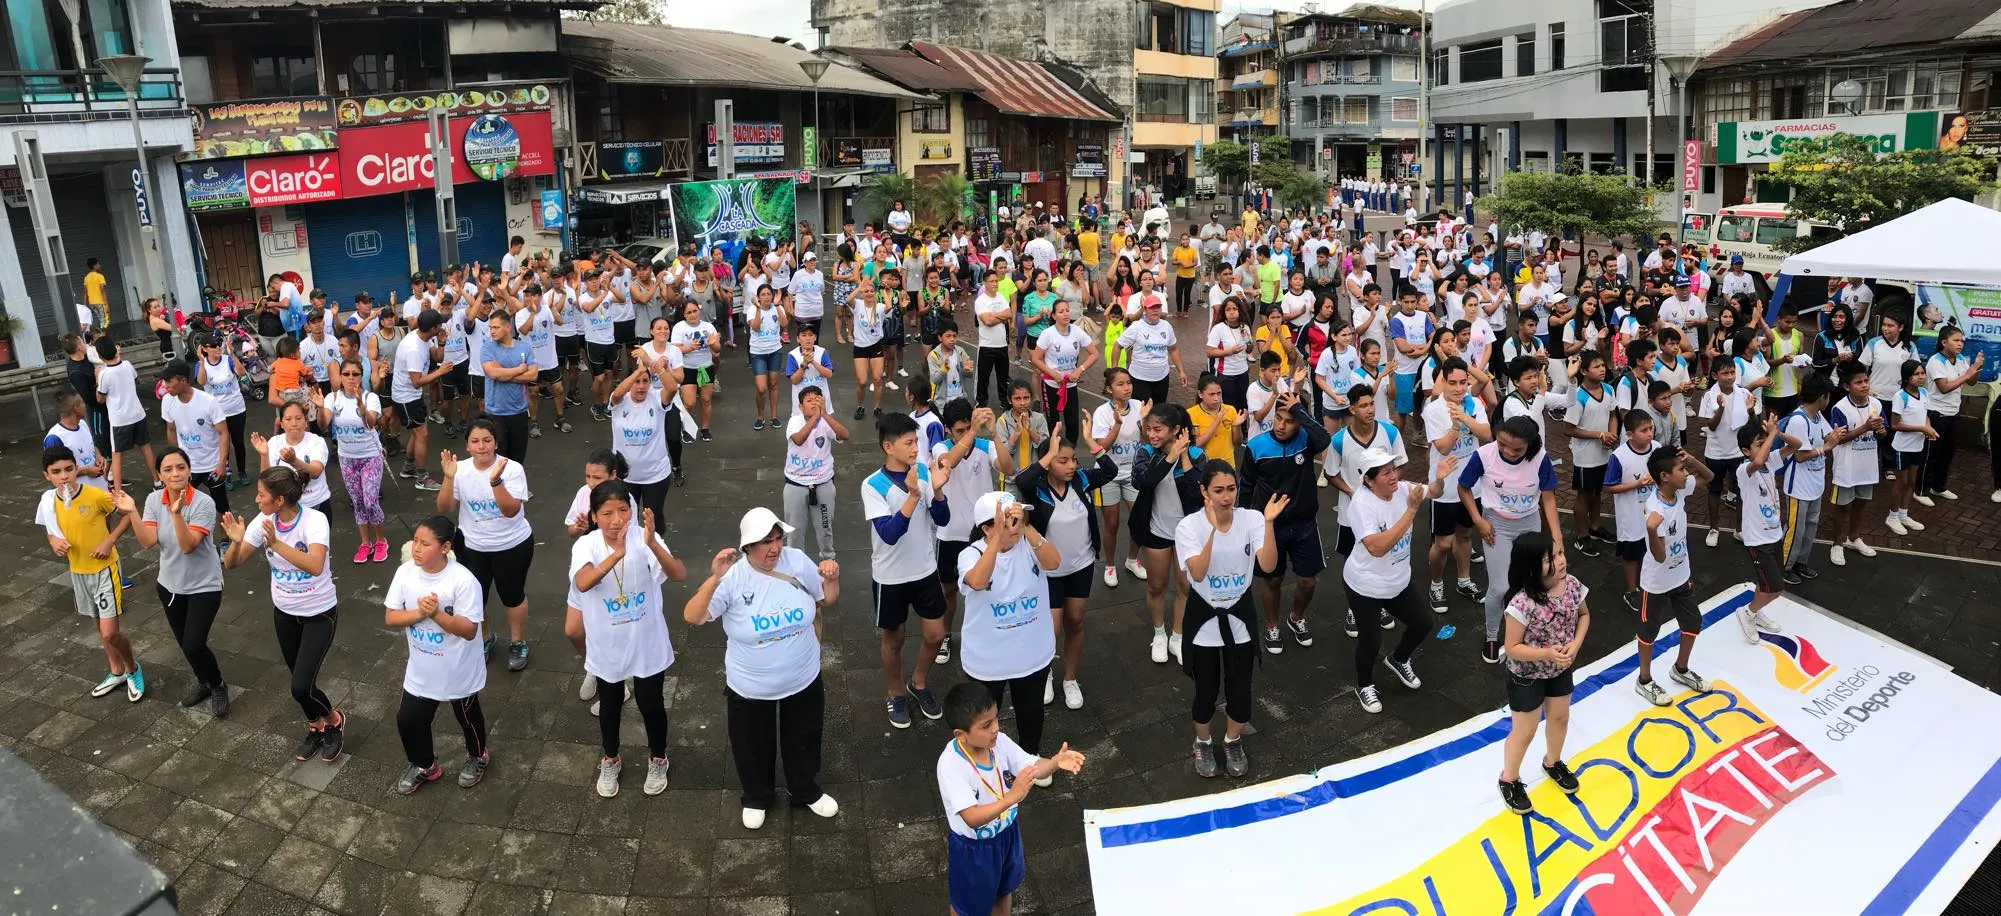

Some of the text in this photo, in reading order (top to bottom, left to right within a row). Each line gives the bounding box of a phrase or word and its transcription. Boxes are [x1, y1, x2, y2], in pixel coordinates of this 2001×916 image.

[769, 124, 784, 144] SRI
[1774, 123, 1837, 133] FARMACIAS
[468, 148, 493, 156] SERVICIO
[803, 128, 813, 166] PUYO
[356, 152, 435, 187] Claro
[1685, 142, 1697, 189] PUYO
[250, 168, 323, 194] Claro
[132, 168, 150, 225] PUYO
[190, 193, 218, 202] SERVICIO
[218, 191, 243, 199] TECNICO
[253, 193, 297, 204] DISTRIBUIDOR
[298, 190, 336, 200] AUTORIZADO
[627, 192, 658, 202] SERVICIOS
[731, 206, 744, 219] LA
[718, 219, 757, 233] CASCADA
[1724, 249, 1788, 260] Cruz Roja Ecuatori
[99, 592, 109, 610] 6
[1801, 664, 1880, 720] Ministerio
[1826, 670, 1916, 742] del Deporte
[1348, 688, 1767, 916] UADOR
